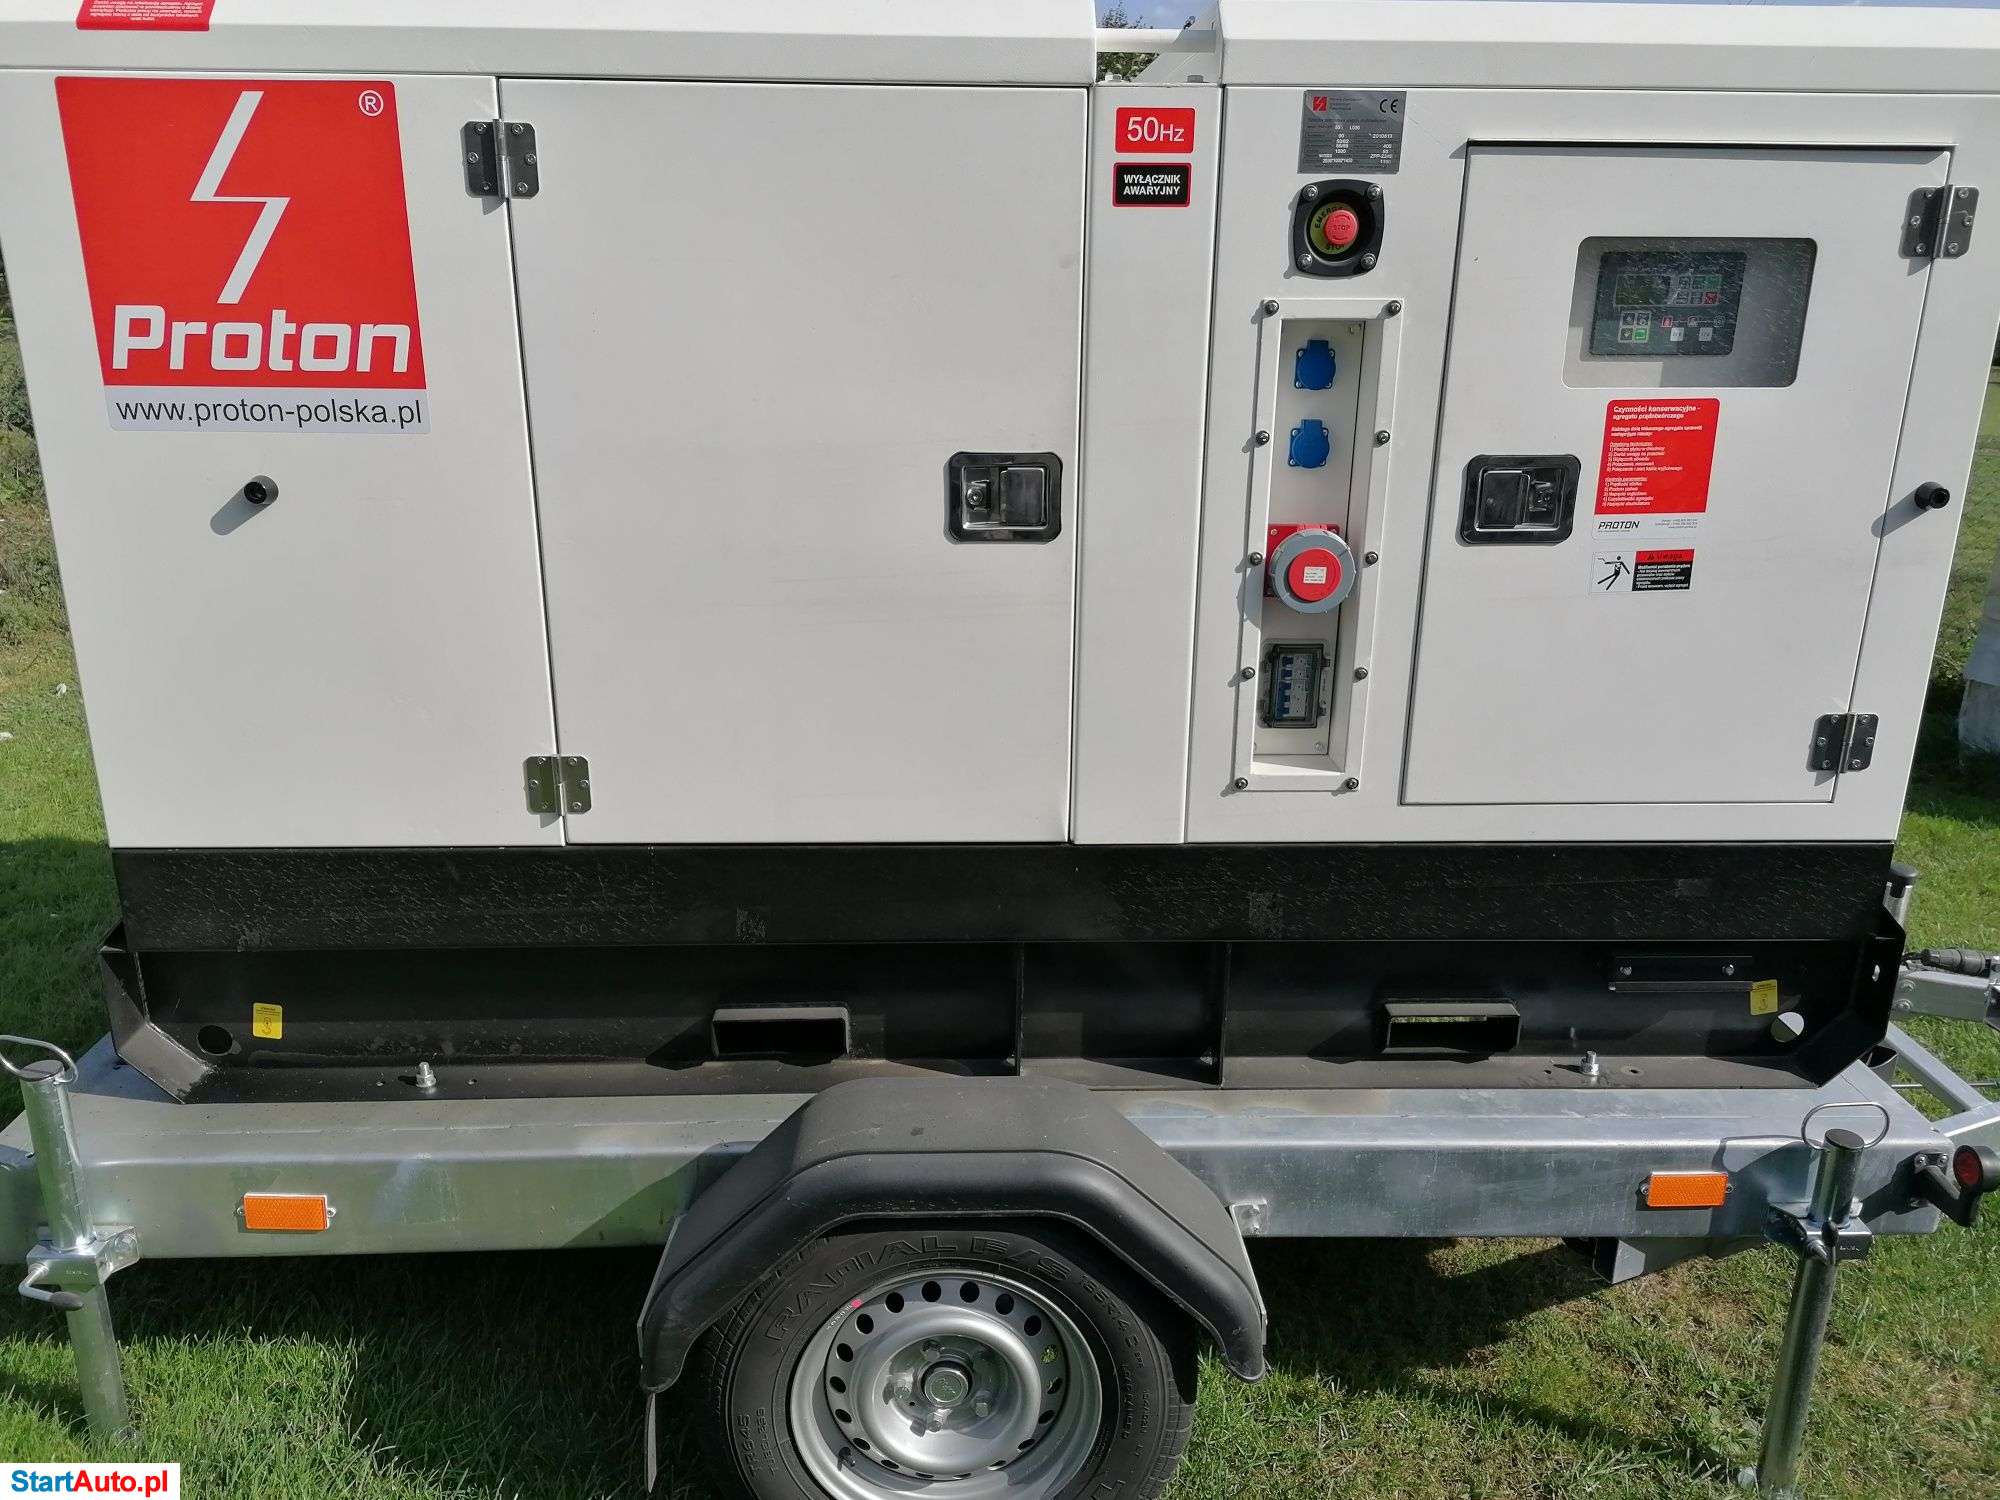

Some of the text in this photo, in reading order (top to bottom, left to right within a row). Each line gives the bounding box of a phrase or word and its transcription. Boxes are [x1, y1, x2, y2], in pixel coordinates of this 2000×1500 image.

[1127, 116, 1185, 142] 50Hz
[1123, 174, 1181, 185] WYŁĄCZNIK
[1123, 186, 1181, 195] AWARYJNY
[112, 304, 411, 373] Proton
[115, 399, 422, 429] www.proton-polska.pl
[1598, 520, 1641, 529] PROTON
